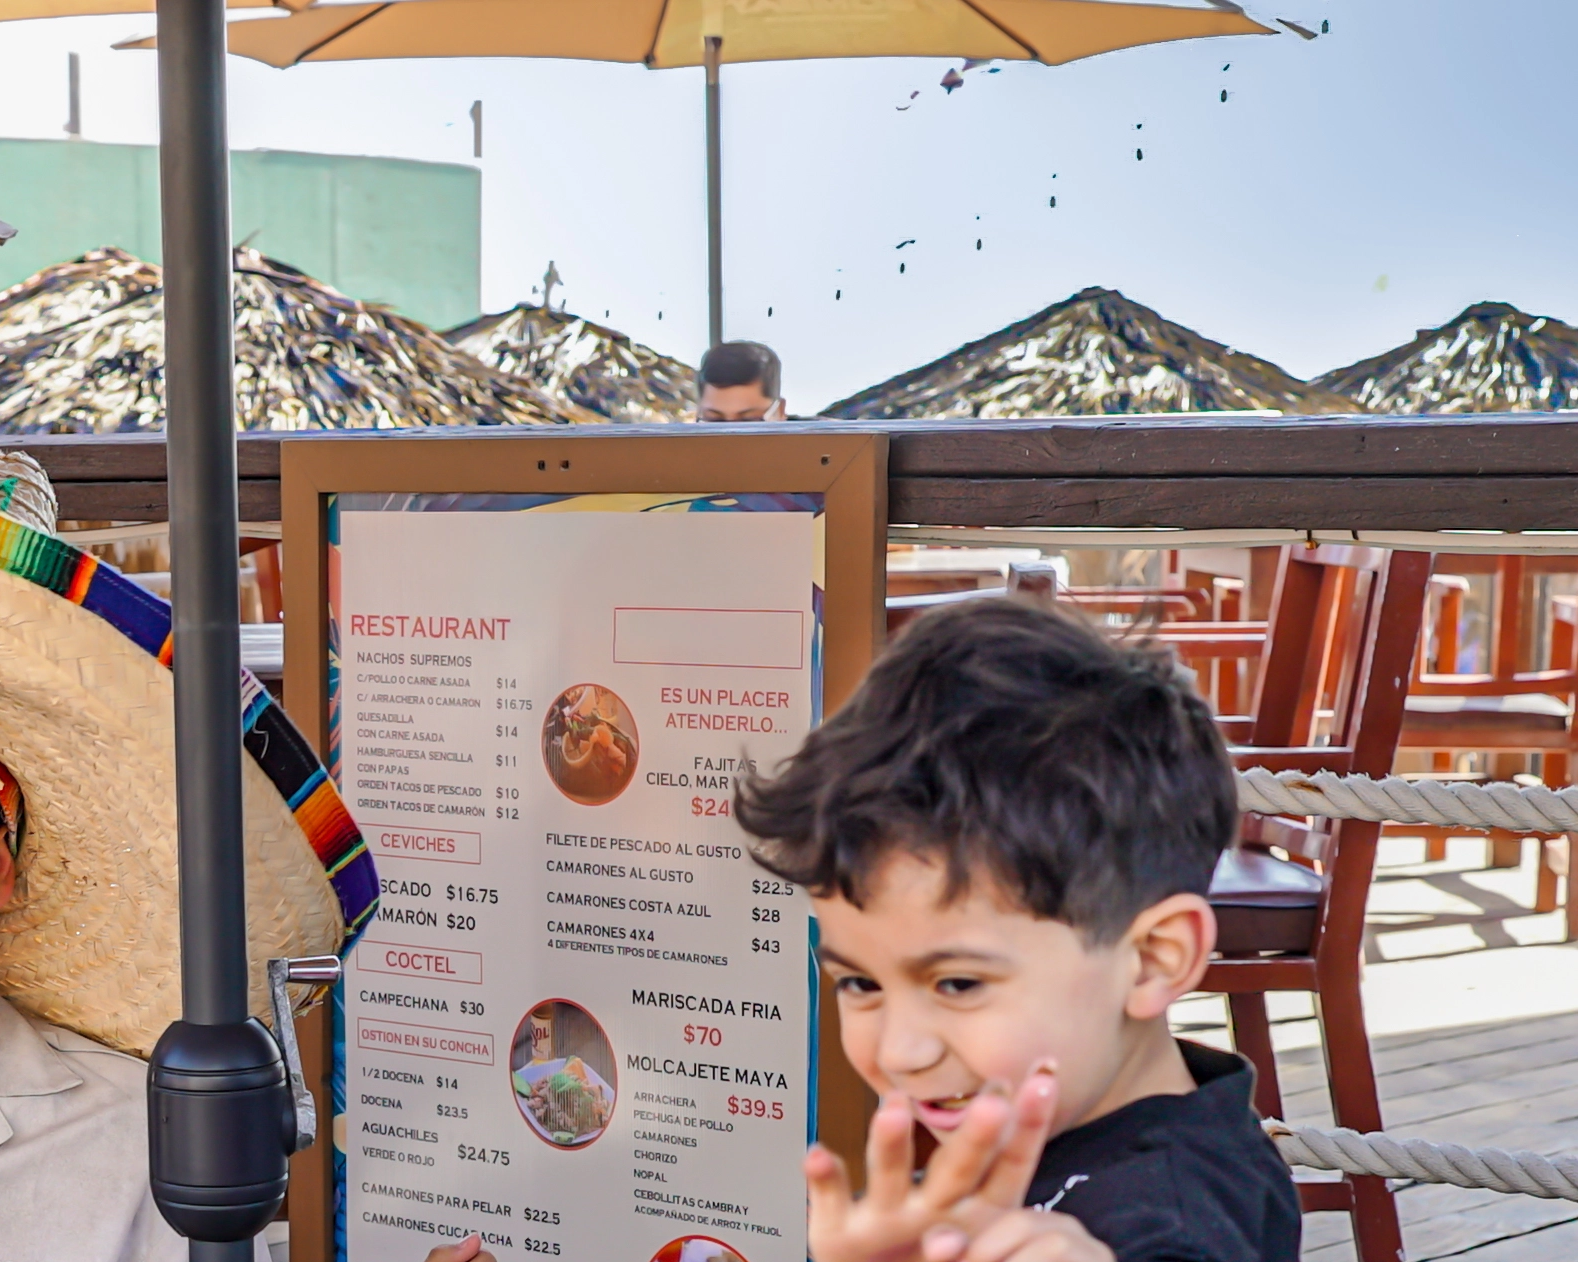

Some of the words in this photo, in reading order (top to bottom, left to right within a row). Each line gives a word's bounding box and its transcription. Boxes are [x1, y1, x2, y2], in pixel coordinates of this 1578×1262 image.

[351, 615, 511, 640] RESTAURANT
[357, 652, 404, 665] NACHOS
[410, 654, 472, 667] SUPREMOS
[357, 674, 397, 684] C/POLLO
[407, 676, 437, 686] CARNE
[439, 677, 470, 687] ASADA
[496, 678, 517, 689] $14
[371, 694, 425, 705] ARRACHERA
[496, 698, 533, 711] $16.75
[661, 687, 682, 703] ES
[687, 688, 712, 705] UN
[717, 690, 789, 708] PLACER
[357, 712, 414, 724] QUESADILLA
[665, 713, 787, 734] ATENDERLO...
[357, 729, 376, 739] CON
[378, 730, 410, 740] CARNE
[413, 732, 445, 743] ASADA
[496, 725, 518, 738] $14
[357, 747, 426, 760] HAMBURGUESA
[429, 751, 473, 763] SENCILLA
[496, 754, 517, 767] $11
[694, 757, 757, 773] FAJITAS
[357, 763, 376, 773] CON
[378, 764, 409, 775] PAPAS
[357, 779, 388, 790] ORDEN
[391, 781, 421, 793] TACOS
[423, 783, 436, 794] DE
[437, 785, 482, 797] PESCADO
[496, 787, 519, 800] $10
[696, 775, 728, 789] MAR
[357, 799, 388, 809] ORDEN
[390, 800, 421, 812] TACOS
[423, 803, 436, 813] DE
[496, 806, 519, 820] $12
[380, 833, 455, 853] CEVICHES
[546, 833, 587, 848] FILETE
[590, 836, 607, 850] DE
[610, 838, 672, 854] PESCADO
[675, 843, 692, 856] AL
[696, 845, 741, 860] GUSTO
[546, 860, 625, 878] CAMARONES
[629, 867, 646, 880] AL
[650, 869, 694, 884] GUSTO
[381, 879, 432, 898] SCADO
[446, 884, 499, 905] $16.75
[752, 879, 794, 896] $22.5
[546, 891, 625, 910] CAMARONES
[629, 899, 673, 915] COSTA
[676, 904, 711, 918] AZUL
[751, 907, 781, 923] $28
[446, 913, 476, 931] $20
[547, 920, 626, 939] CAMARONES
[629, 929, 655, 942] 4X4
[751, 938, 780, 954] $43
[385, 950, 456, 975] COCTEL
[547, 939, 554, 948] 4
[556, 940, 614, 955] DIFERENTES
[616, 945, 645, 958] TIPOS
[647, 949, 660, 960] DE
[662, 950, 728, 966] CAMARONES
[360, 990, 449, 1013] CAMPECHANA
[460, 1001, 485, 1016] $30
[632, 989, 736, 1016] MARISCADA
[741, 1002, 782, 1021] FRIA
[361, 1029, 402, 1045] OSTION
[404, 1034, 420, 1046] EN
[422, 1037, 437, 1049] SU
[440, 1039, 489, 1056] CONCHA
[683, 1023, 722, 1046] $70
[382, 1069, 424, 1085] DOCENA
[436, 1076, 458, 1090] $14
[627, 1054, 730, 1082] MOLCAJETE
[735, 1068, 788, 1089] MAYA
[361, 1094, 403, 1110] DOCENA
[436, 1104, 468, 1119] $23.5
[634, 1091, 697, 1109] ARRACHERA
[727, 1095, 784, 1120] $39.5
[633, 1110, 681, 1126] PECHUGA
[684, 1117, 697, 1128] DE
[700, 1119, 734, 1132] POLLO
[362, 1122, 438, 1143] AGUACHILES
[634, 1130, 697, 1147] CAMARONES
[362, 1147, 396, 1161] VERDE
[398, 1152, 405, 1162] O
[407, 1154, 435, 1167] ROJO
[457, 1144, 510, 1166] $24.75
[634, 1150, 678, 1165] CHORIZO
[634, 1169, 668, 1183] NOPAL
[362, 1182, 434, 1204] CAMARONES
[436, 1195, 469, 1211] PARA
[473, 1201, 511, 1217] PELAR
[524, 1207, 561, 1225] $22.5
[634, 1189, 695, 1208] CEBOLLITAS
[697, 1199, 749, 1216] CAMBRAY
[362, 1211, 435, 1234] CAMARONES
[437, 1224, 513, 1248] CUCAACHA
[524, 1238, 561, 1256] $22.5
[697, 1215, 709, 1225] DE
[711, 1218, 741, 1231] ARROZ
[743, 1223, 750, 1232] Y
[751, 1224, 782, 1238] FRIJOL
